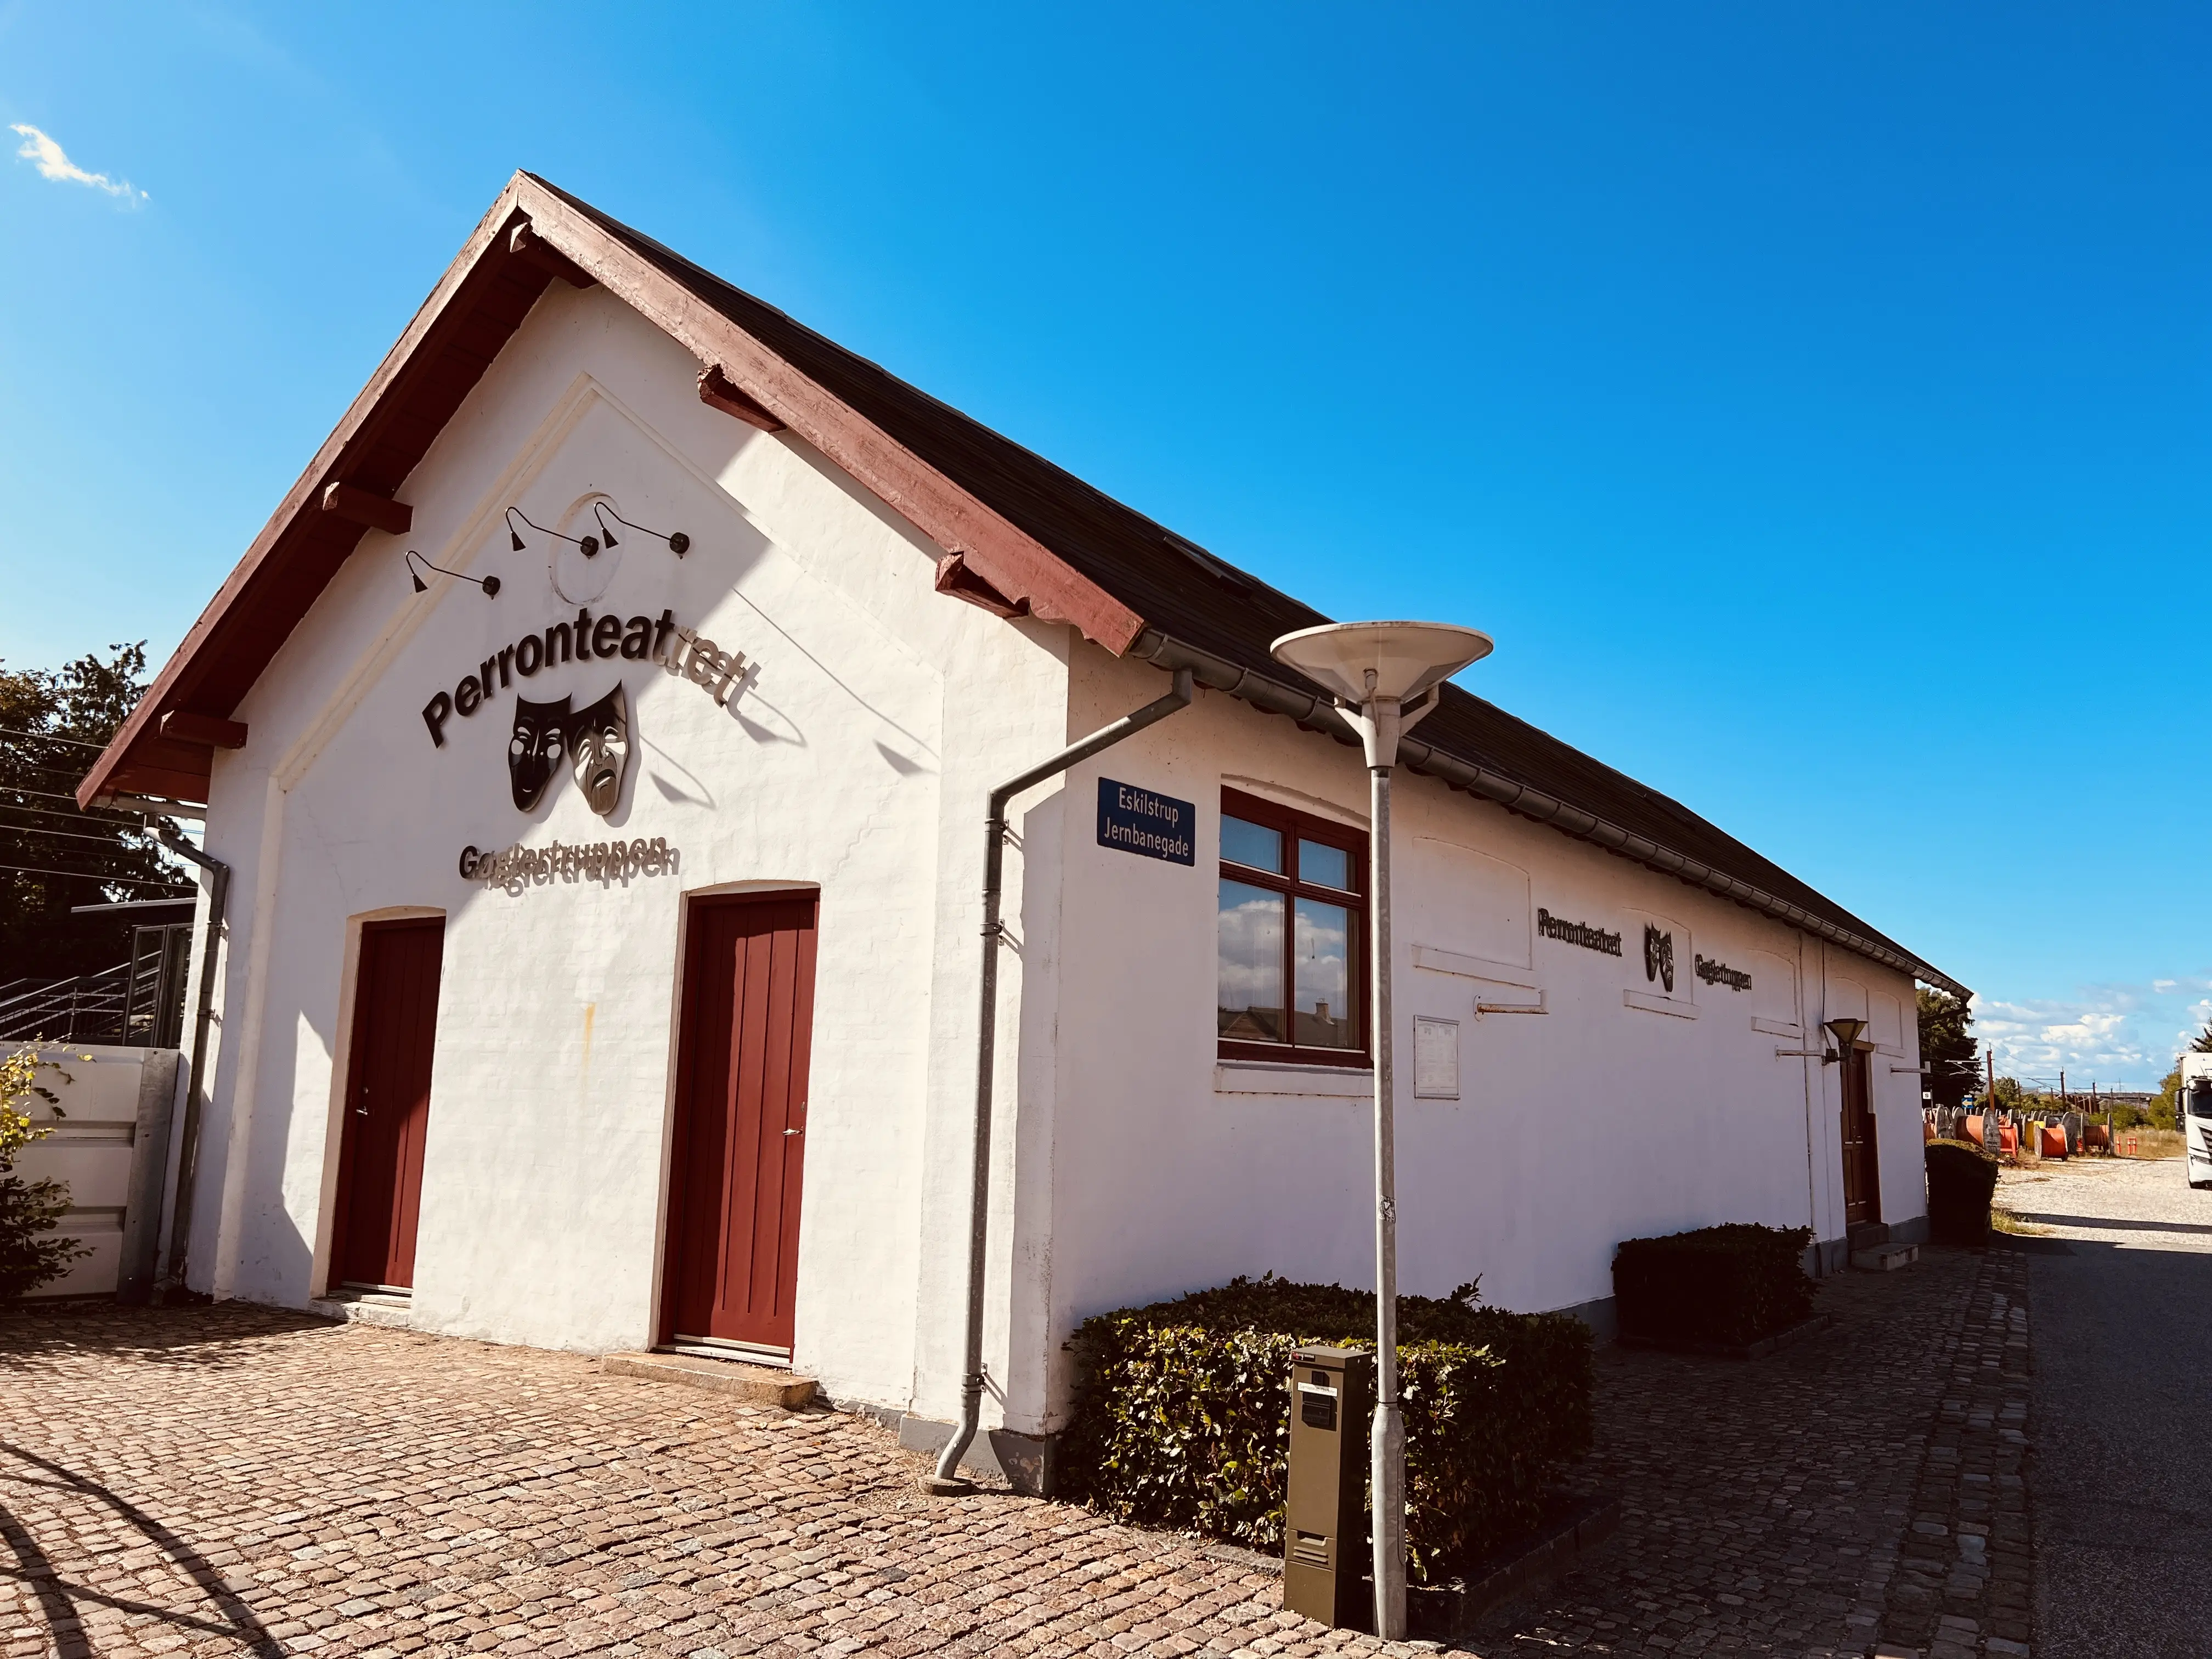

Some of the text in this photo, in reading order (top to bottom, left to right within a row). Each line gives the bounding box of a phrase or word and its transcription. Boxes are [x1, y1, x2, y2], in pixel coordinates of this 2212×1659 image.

[421, 607, 747, 748] Perronteatret
[1119, 787, 1178, 828] Eskilstrup
[1104, 817, 1188, 858] Jernbanegade
